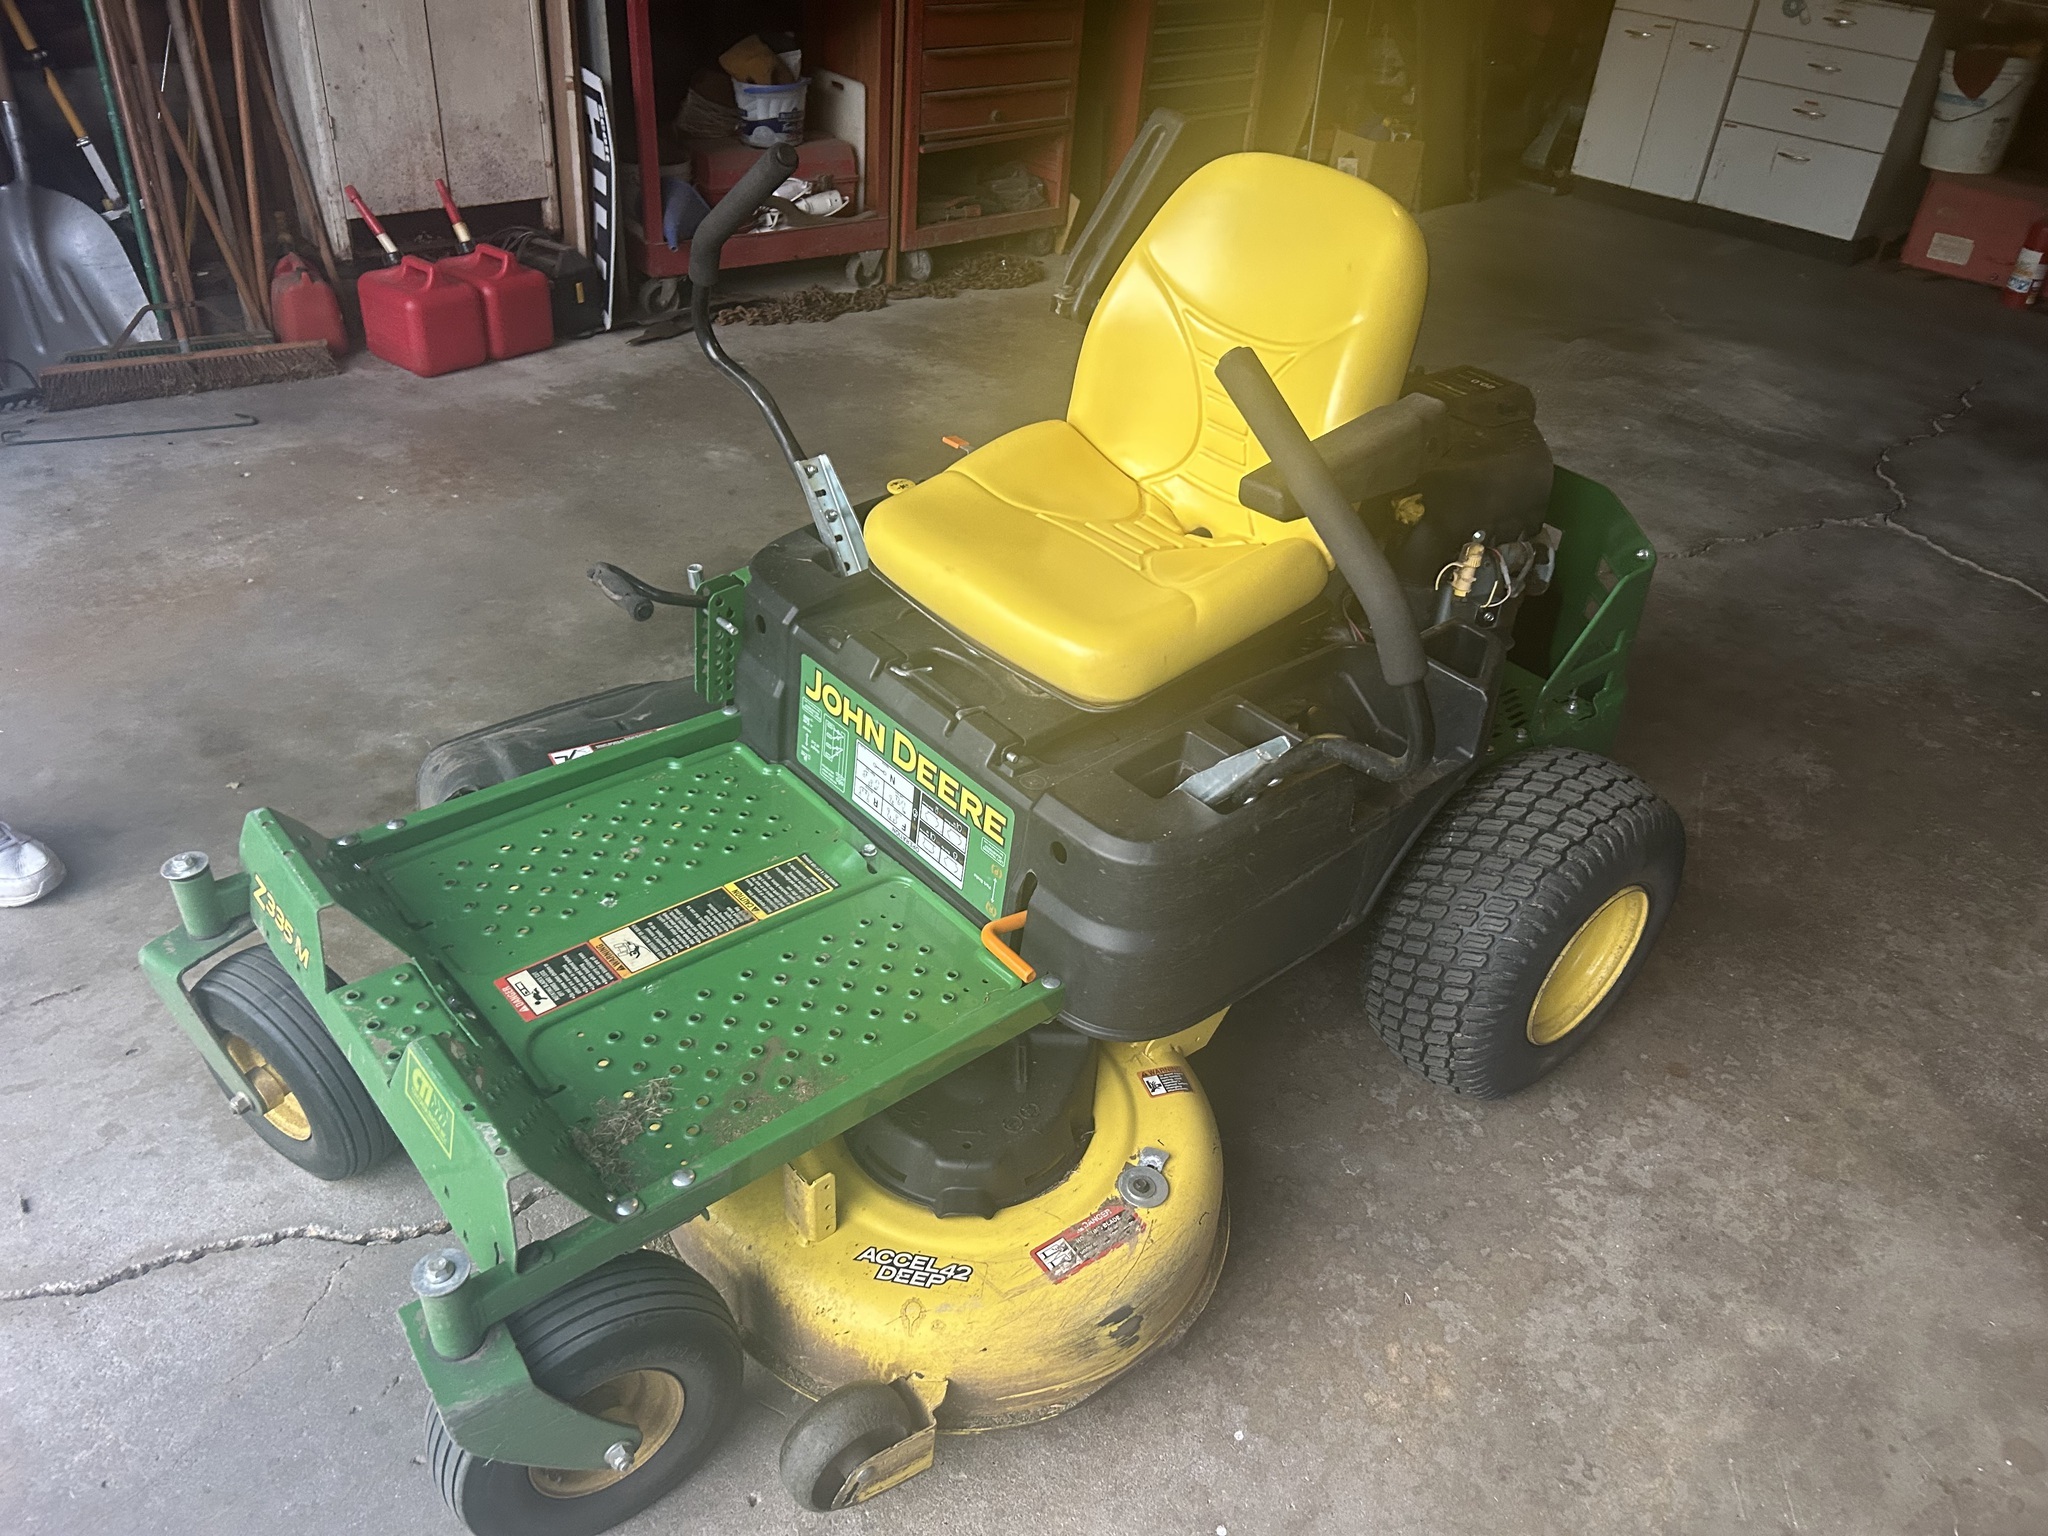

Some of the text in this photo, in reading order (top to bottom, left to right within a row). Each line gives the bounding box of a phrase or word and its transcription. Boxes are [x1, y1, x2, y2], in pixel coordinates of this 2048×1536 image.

[804, 669, 887, 754] JOHN
[891, 727, 1008, 847] DEERE
[730, 888, 755, 908] CAUTION
[594, 942, 621, 967] WARNING
[500, 984, 525, 1008] DANGER
[855, 1246, 939, 1273] ACCEL
[874, 1263, 948, 1288] DEEP
